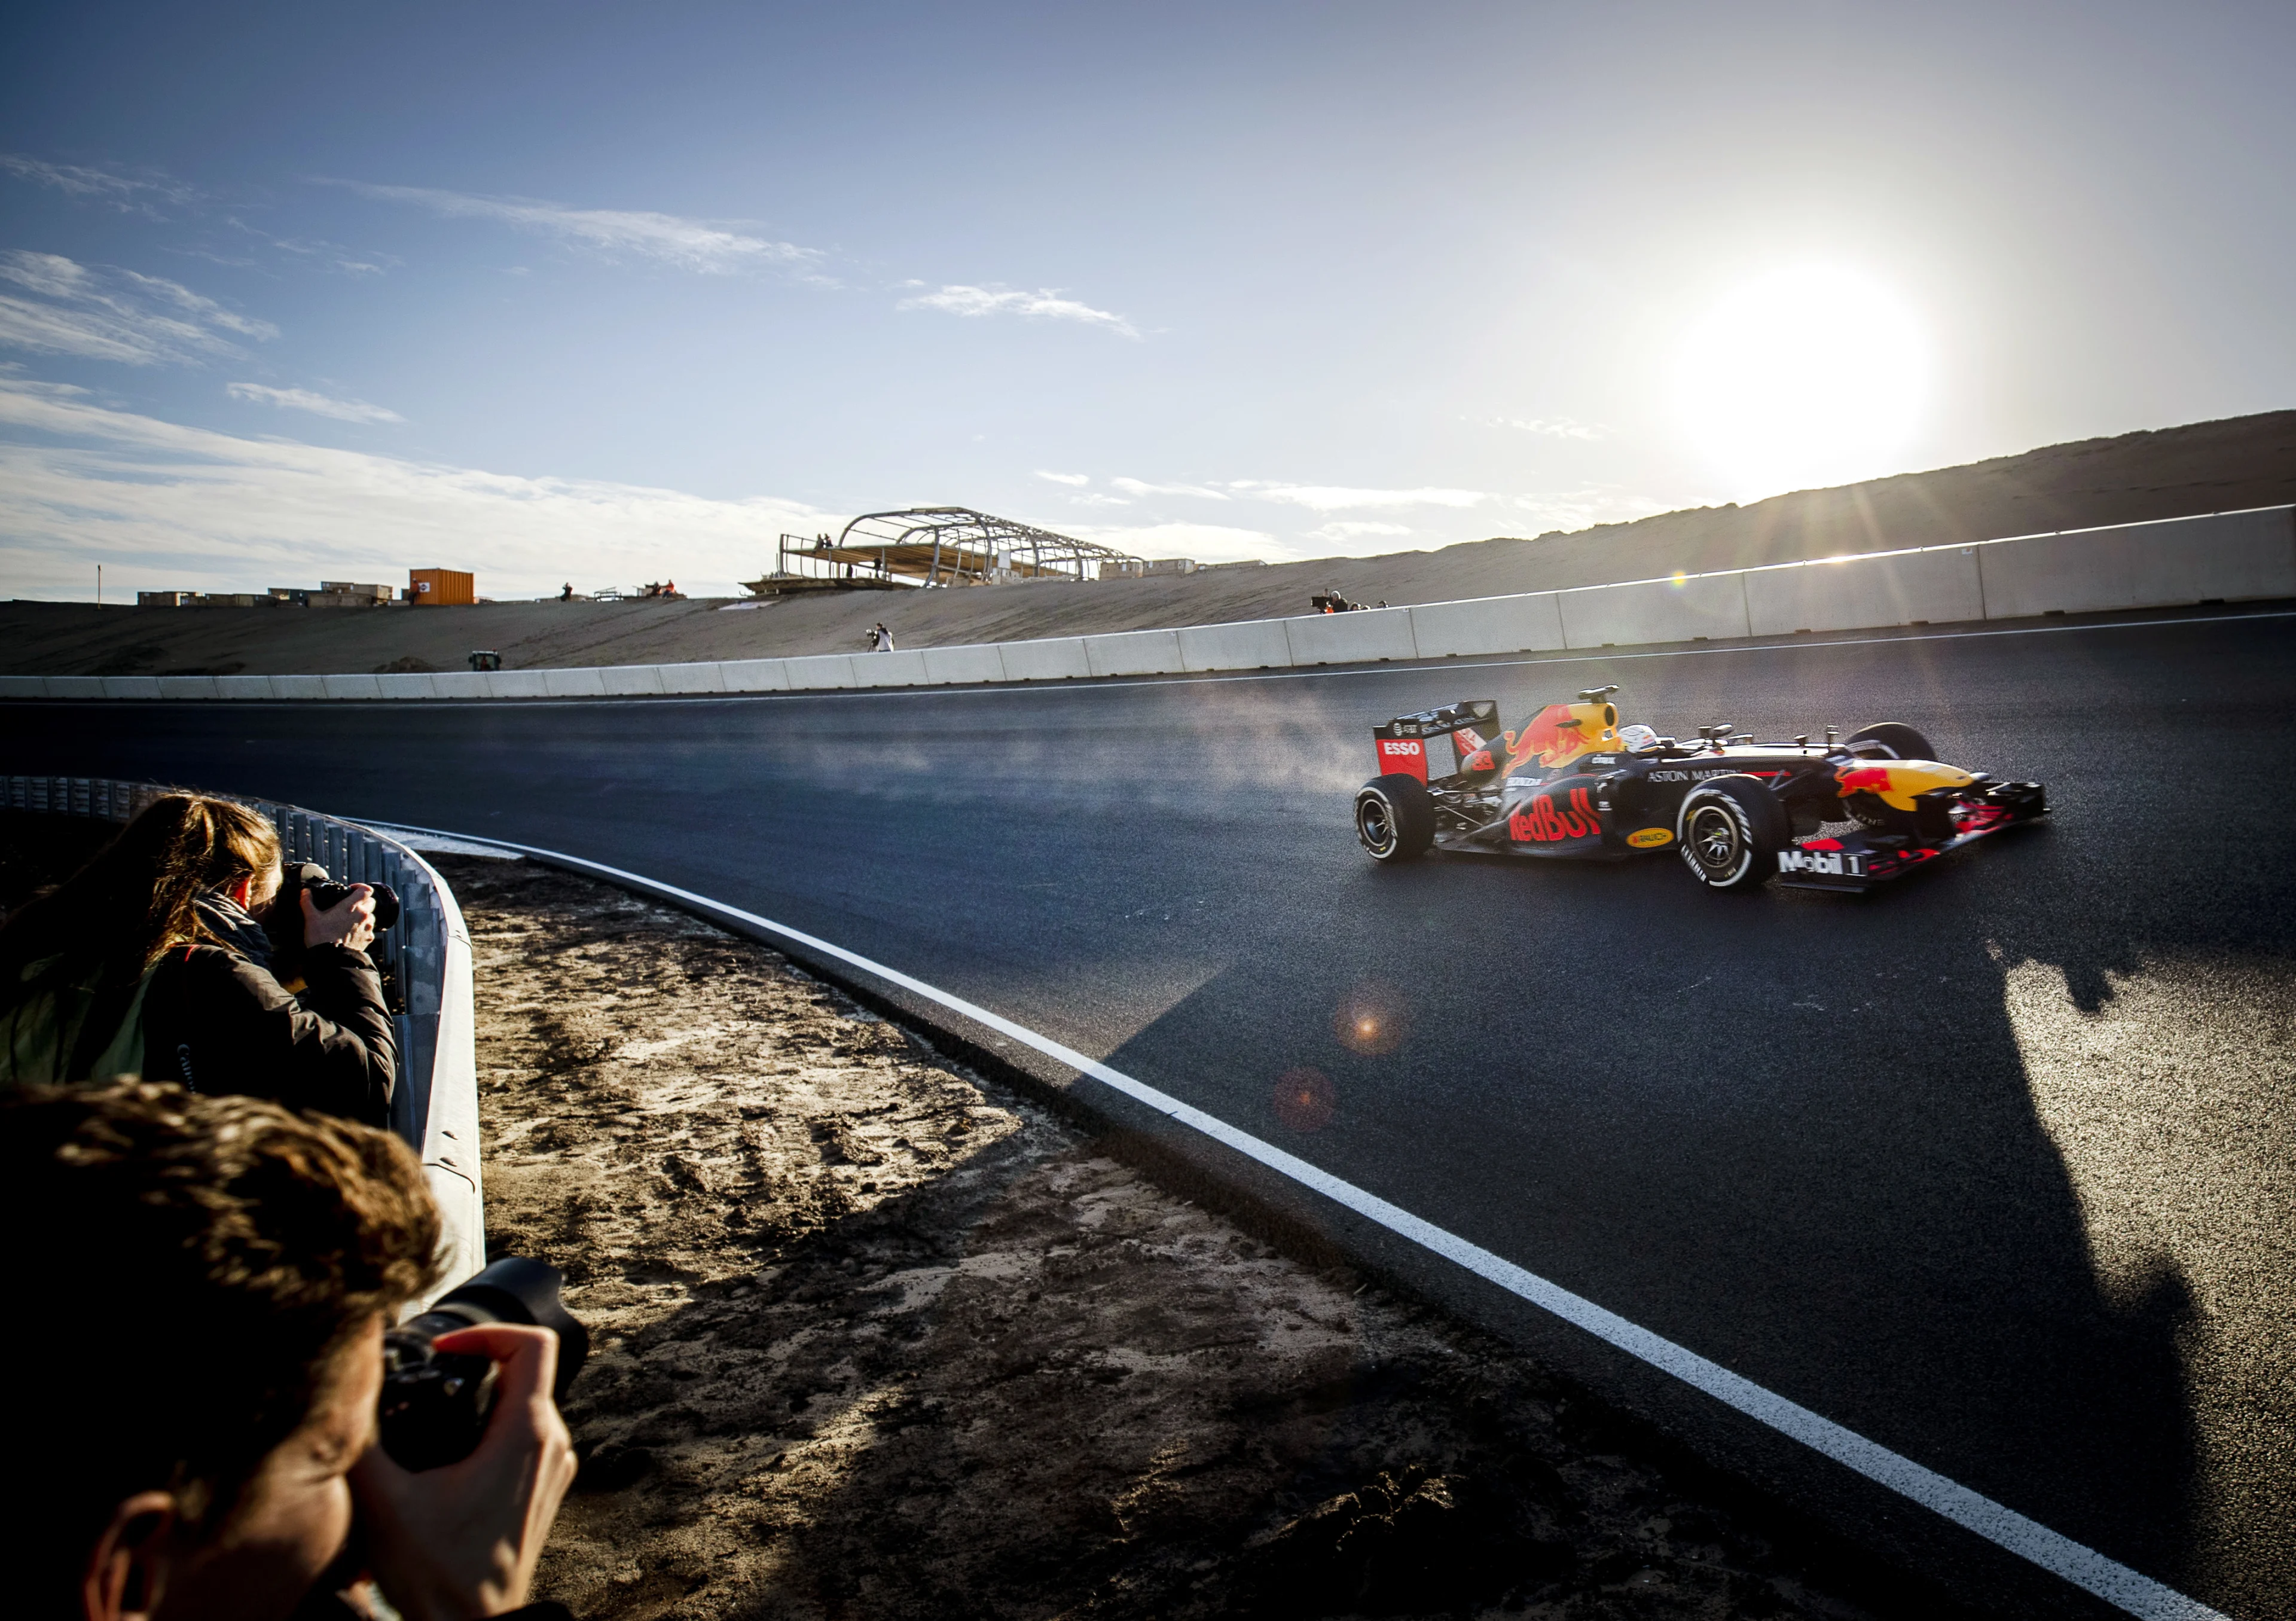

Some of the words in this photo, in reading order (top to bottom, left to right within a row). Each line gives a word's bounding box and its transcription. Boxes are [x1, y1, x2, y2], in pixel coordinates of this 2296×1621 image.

[1384, 741, 1420, 756] ESSO
[1647, 771, 1689, 782] ASTON
[1777, 850, 1843, 874] Mobil
[1848, 855, 1860, 874] 1
